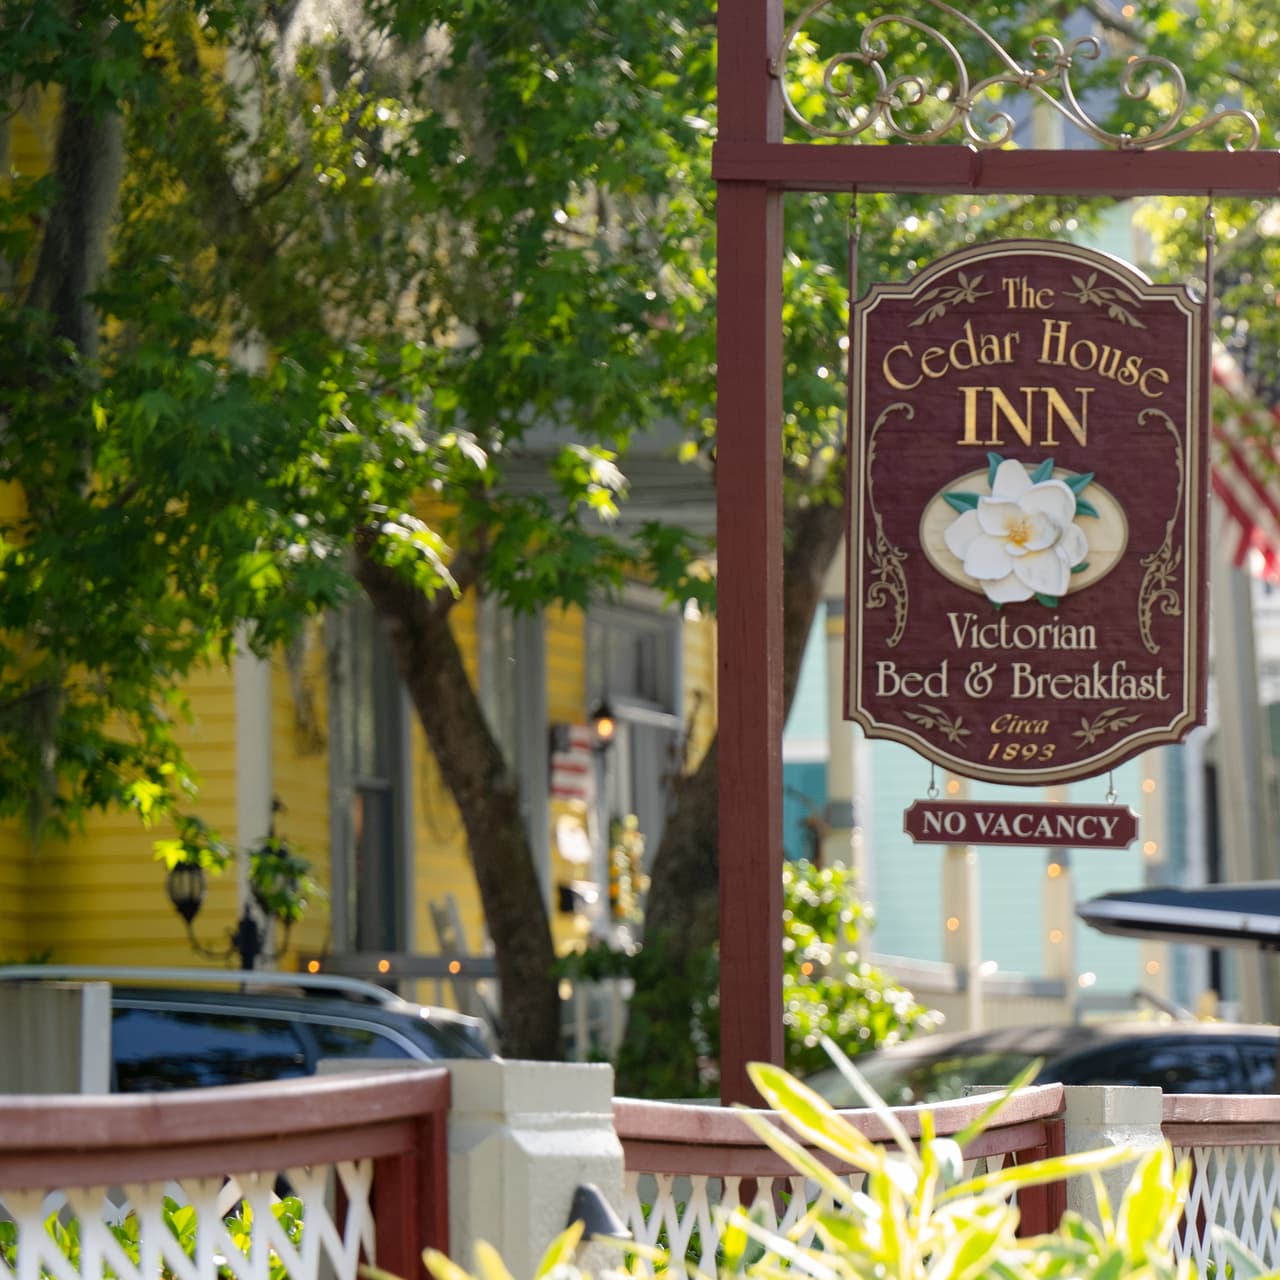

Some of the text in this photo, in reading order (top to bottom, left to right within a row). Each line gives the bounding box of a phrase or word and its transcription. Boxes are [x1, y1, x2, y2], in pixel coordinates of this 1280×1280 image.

[1002, 276, 1055, 310] The
[882, 318, 1169, 398] Cedar House
[956, 386, 1095, 447] INN
[947, 612, 1097, 650] Victorian
[875, 659, 1171, 701] Bed & Breakfast
[990, 713, 1049, 735] Circa
[987, 742, 1057, 762] 1893
[922, 810, 1119, 840] NO VACANCY
